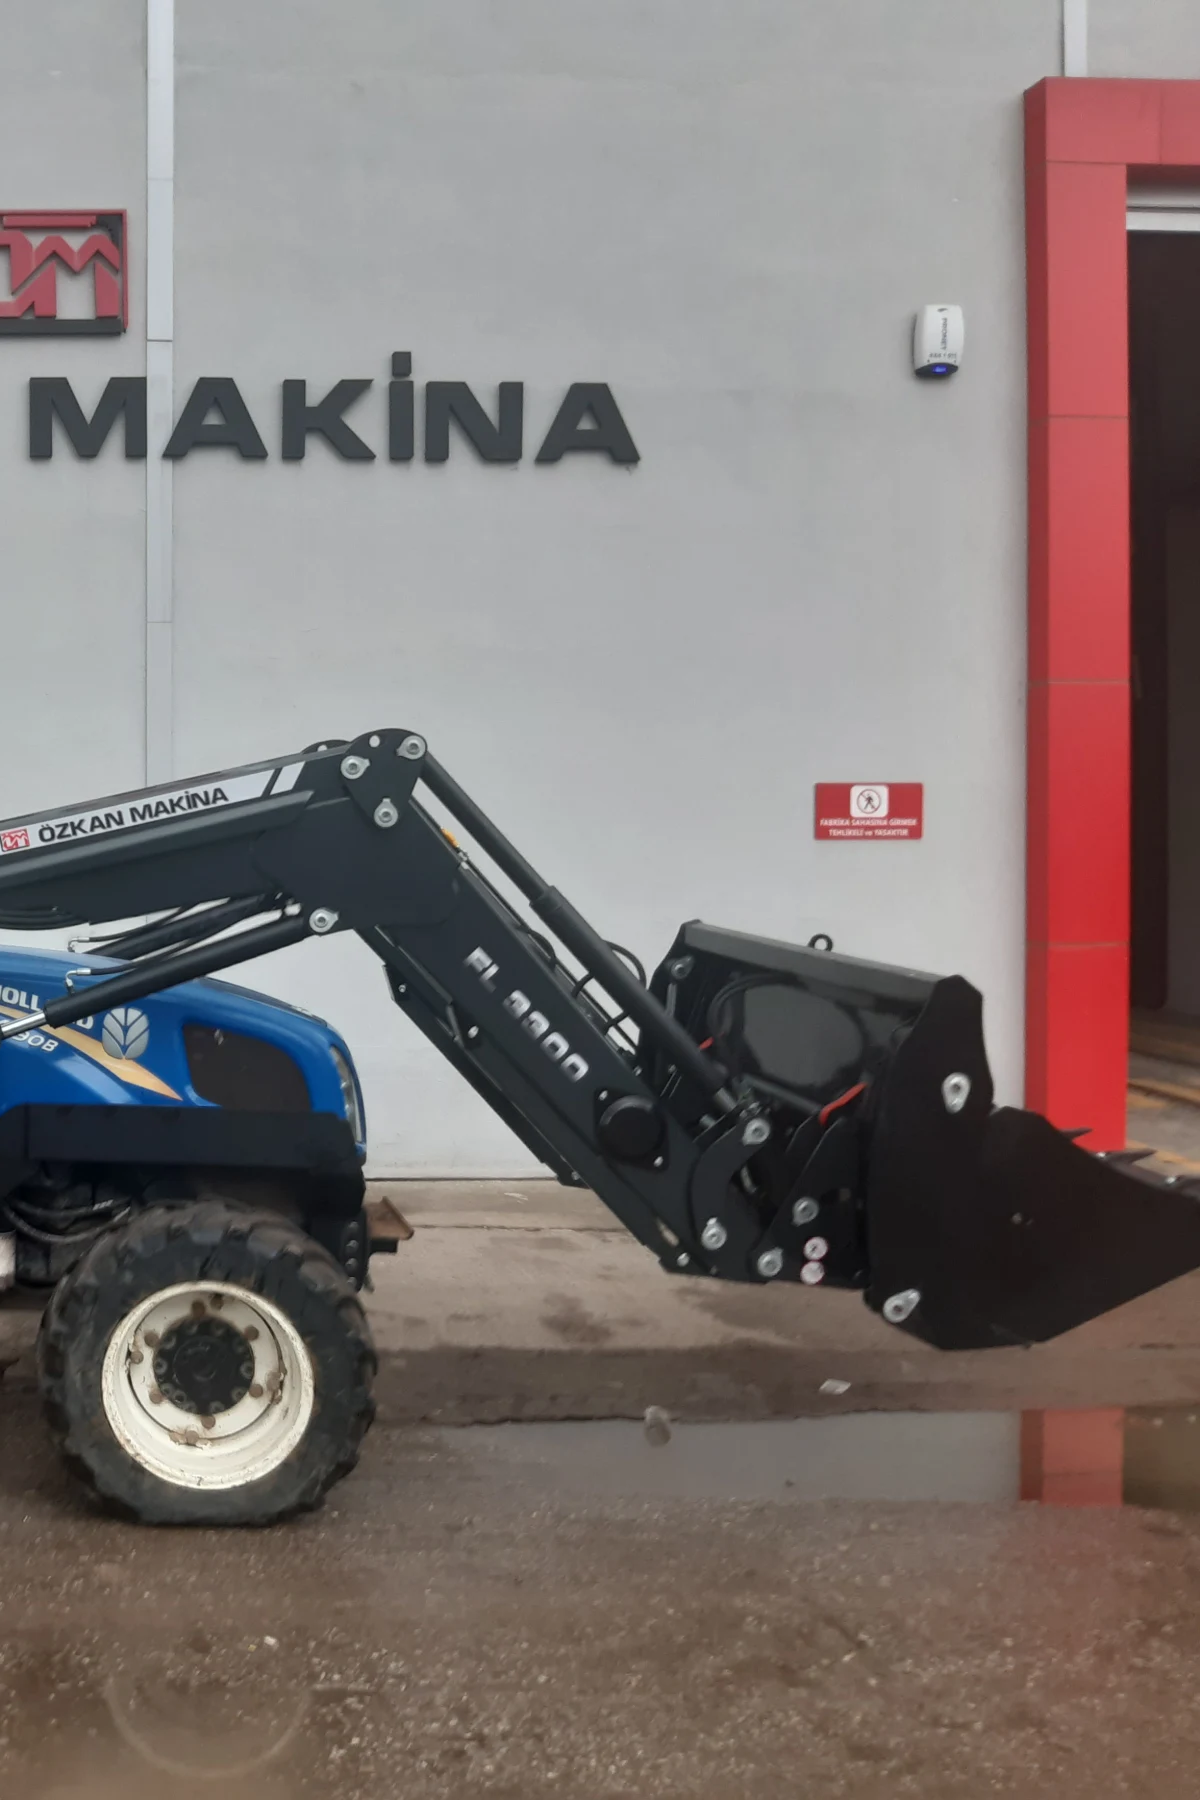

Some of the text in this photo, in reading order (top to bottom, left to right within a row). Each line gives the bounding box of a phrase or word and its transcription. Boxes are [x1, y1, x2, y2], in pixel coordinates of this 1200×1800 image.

[29, 351, 641, 464] MAKİNA
[38, 810, 125, 843] ÖZKAN
[129, 787, 229, 823] MAKİNA
[464, 946, 589, 1082] FL 3300
